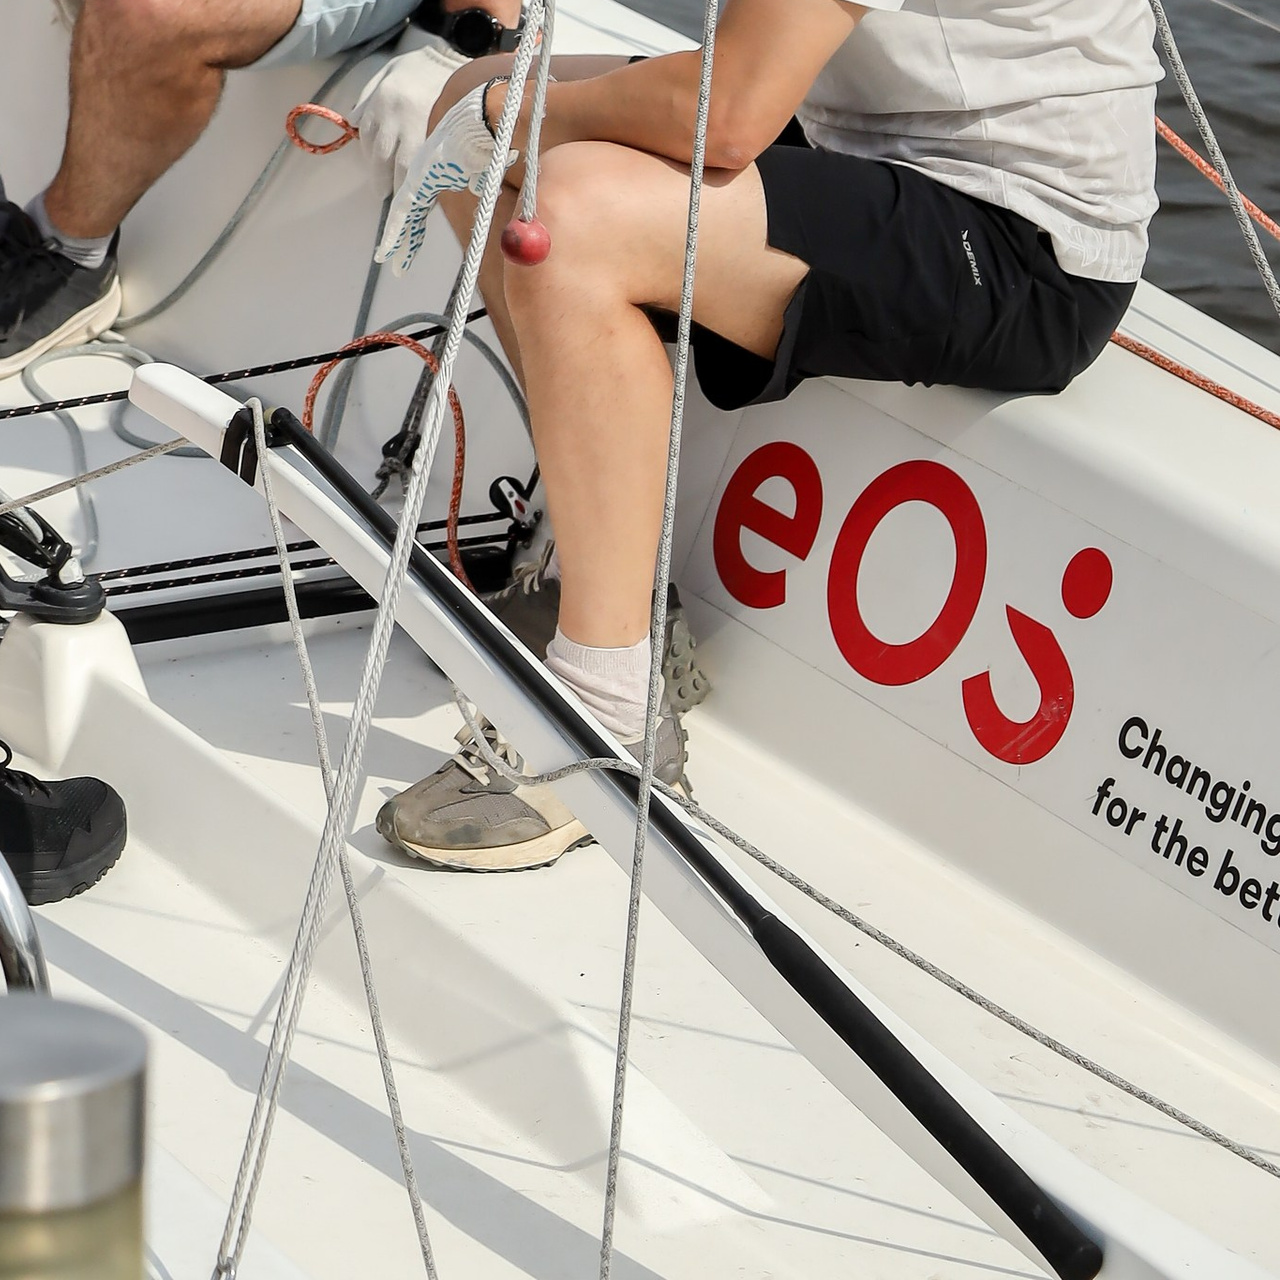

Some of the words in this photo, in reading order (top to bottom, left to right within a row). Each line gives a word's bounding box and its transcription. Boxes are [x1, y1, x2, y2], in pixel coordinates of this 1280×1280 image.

[962, 241, 983, 286] DEMIX
[1091, 777, 1147, 837] for
[1150, 813, 1209, 877] the
[1213, 848, 1280, 930] bet
[1118, 716, 1280, 857] Changing
